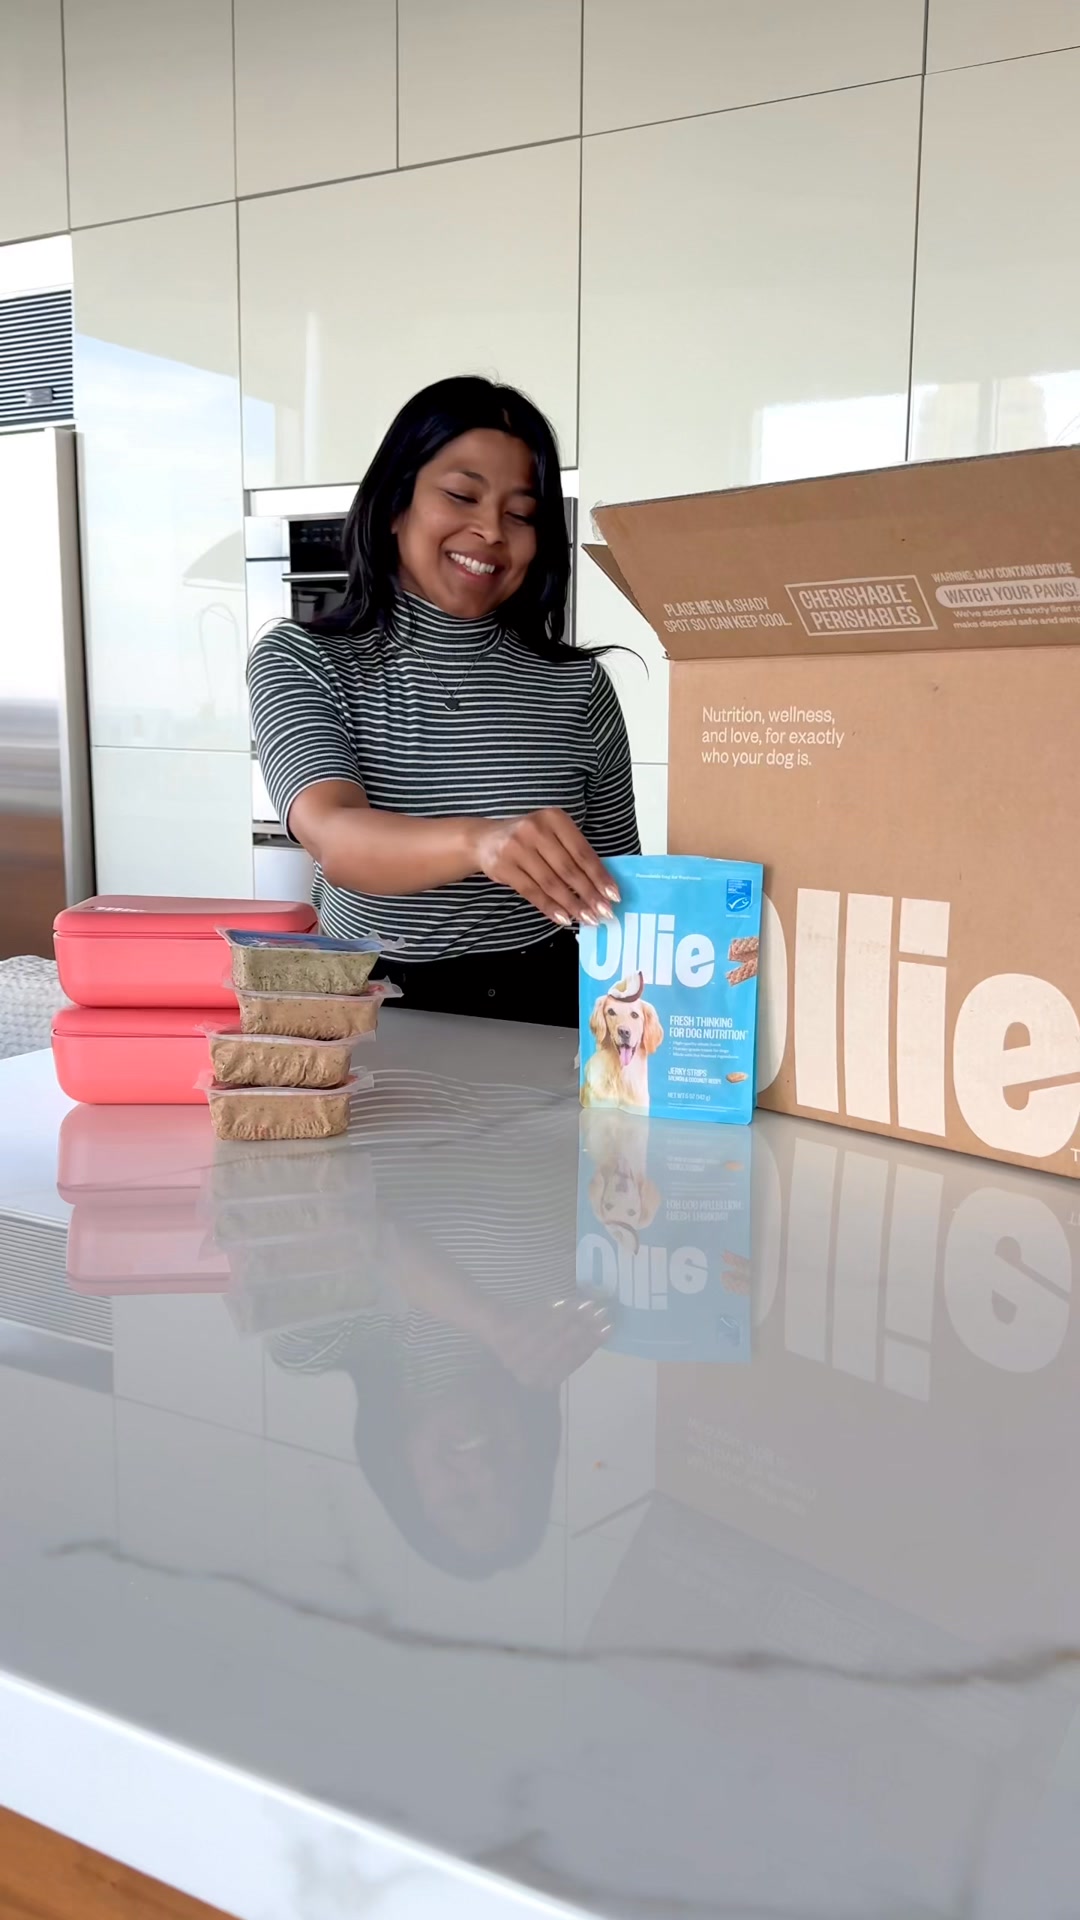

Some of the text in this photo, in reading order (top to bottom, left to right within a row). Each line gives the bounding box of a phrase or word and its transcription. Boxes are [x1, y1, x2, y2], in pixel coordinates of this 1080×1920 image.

[974, 567, 996, 580] MAY
[995, 564, 1037, 579] CONTAIN
[1035, 563, 1057, 577] DRY
[799, 584, 912, 610] CHERISHABLE
[944, 582, 1080, 604] WATCH YOUR PAWS!
[663, 597, 770, 617] PLACE ME IN A SHADY
[952, 610, 982, 618] We've
[982, 607, 1012, 617] added
[1018, 605, 1050, 616] handy
[663, 618, 692, 633] SPOT
[689, 617, 706, 632] SO
[709, 615, 737, 630] CAN
[731, 614, 760, 629] KEEP
[810, 605, 921, 630] PERISHABLES
[953, 621, 979, 629] make
[979, 617, 1019, 628] disposal
[1018, 617, 1040, 626] safe
[1039, 616, 1059, 625] and
[702, 705, 836, 725] Nutrition, wellness,
[701, 727, 845, 749] and love, for exactly
[701, 747, 813, 770] who your dog is.
[578, 912, 715, 988] Ollie
[669, 1016, 733, 1028] FRESH THINKING
[669, 1027, 685, 1038] FOR
[685, 1028, 702, 1039] DOG
[667, 1067, 708, 1078] JERKY STRIPS
